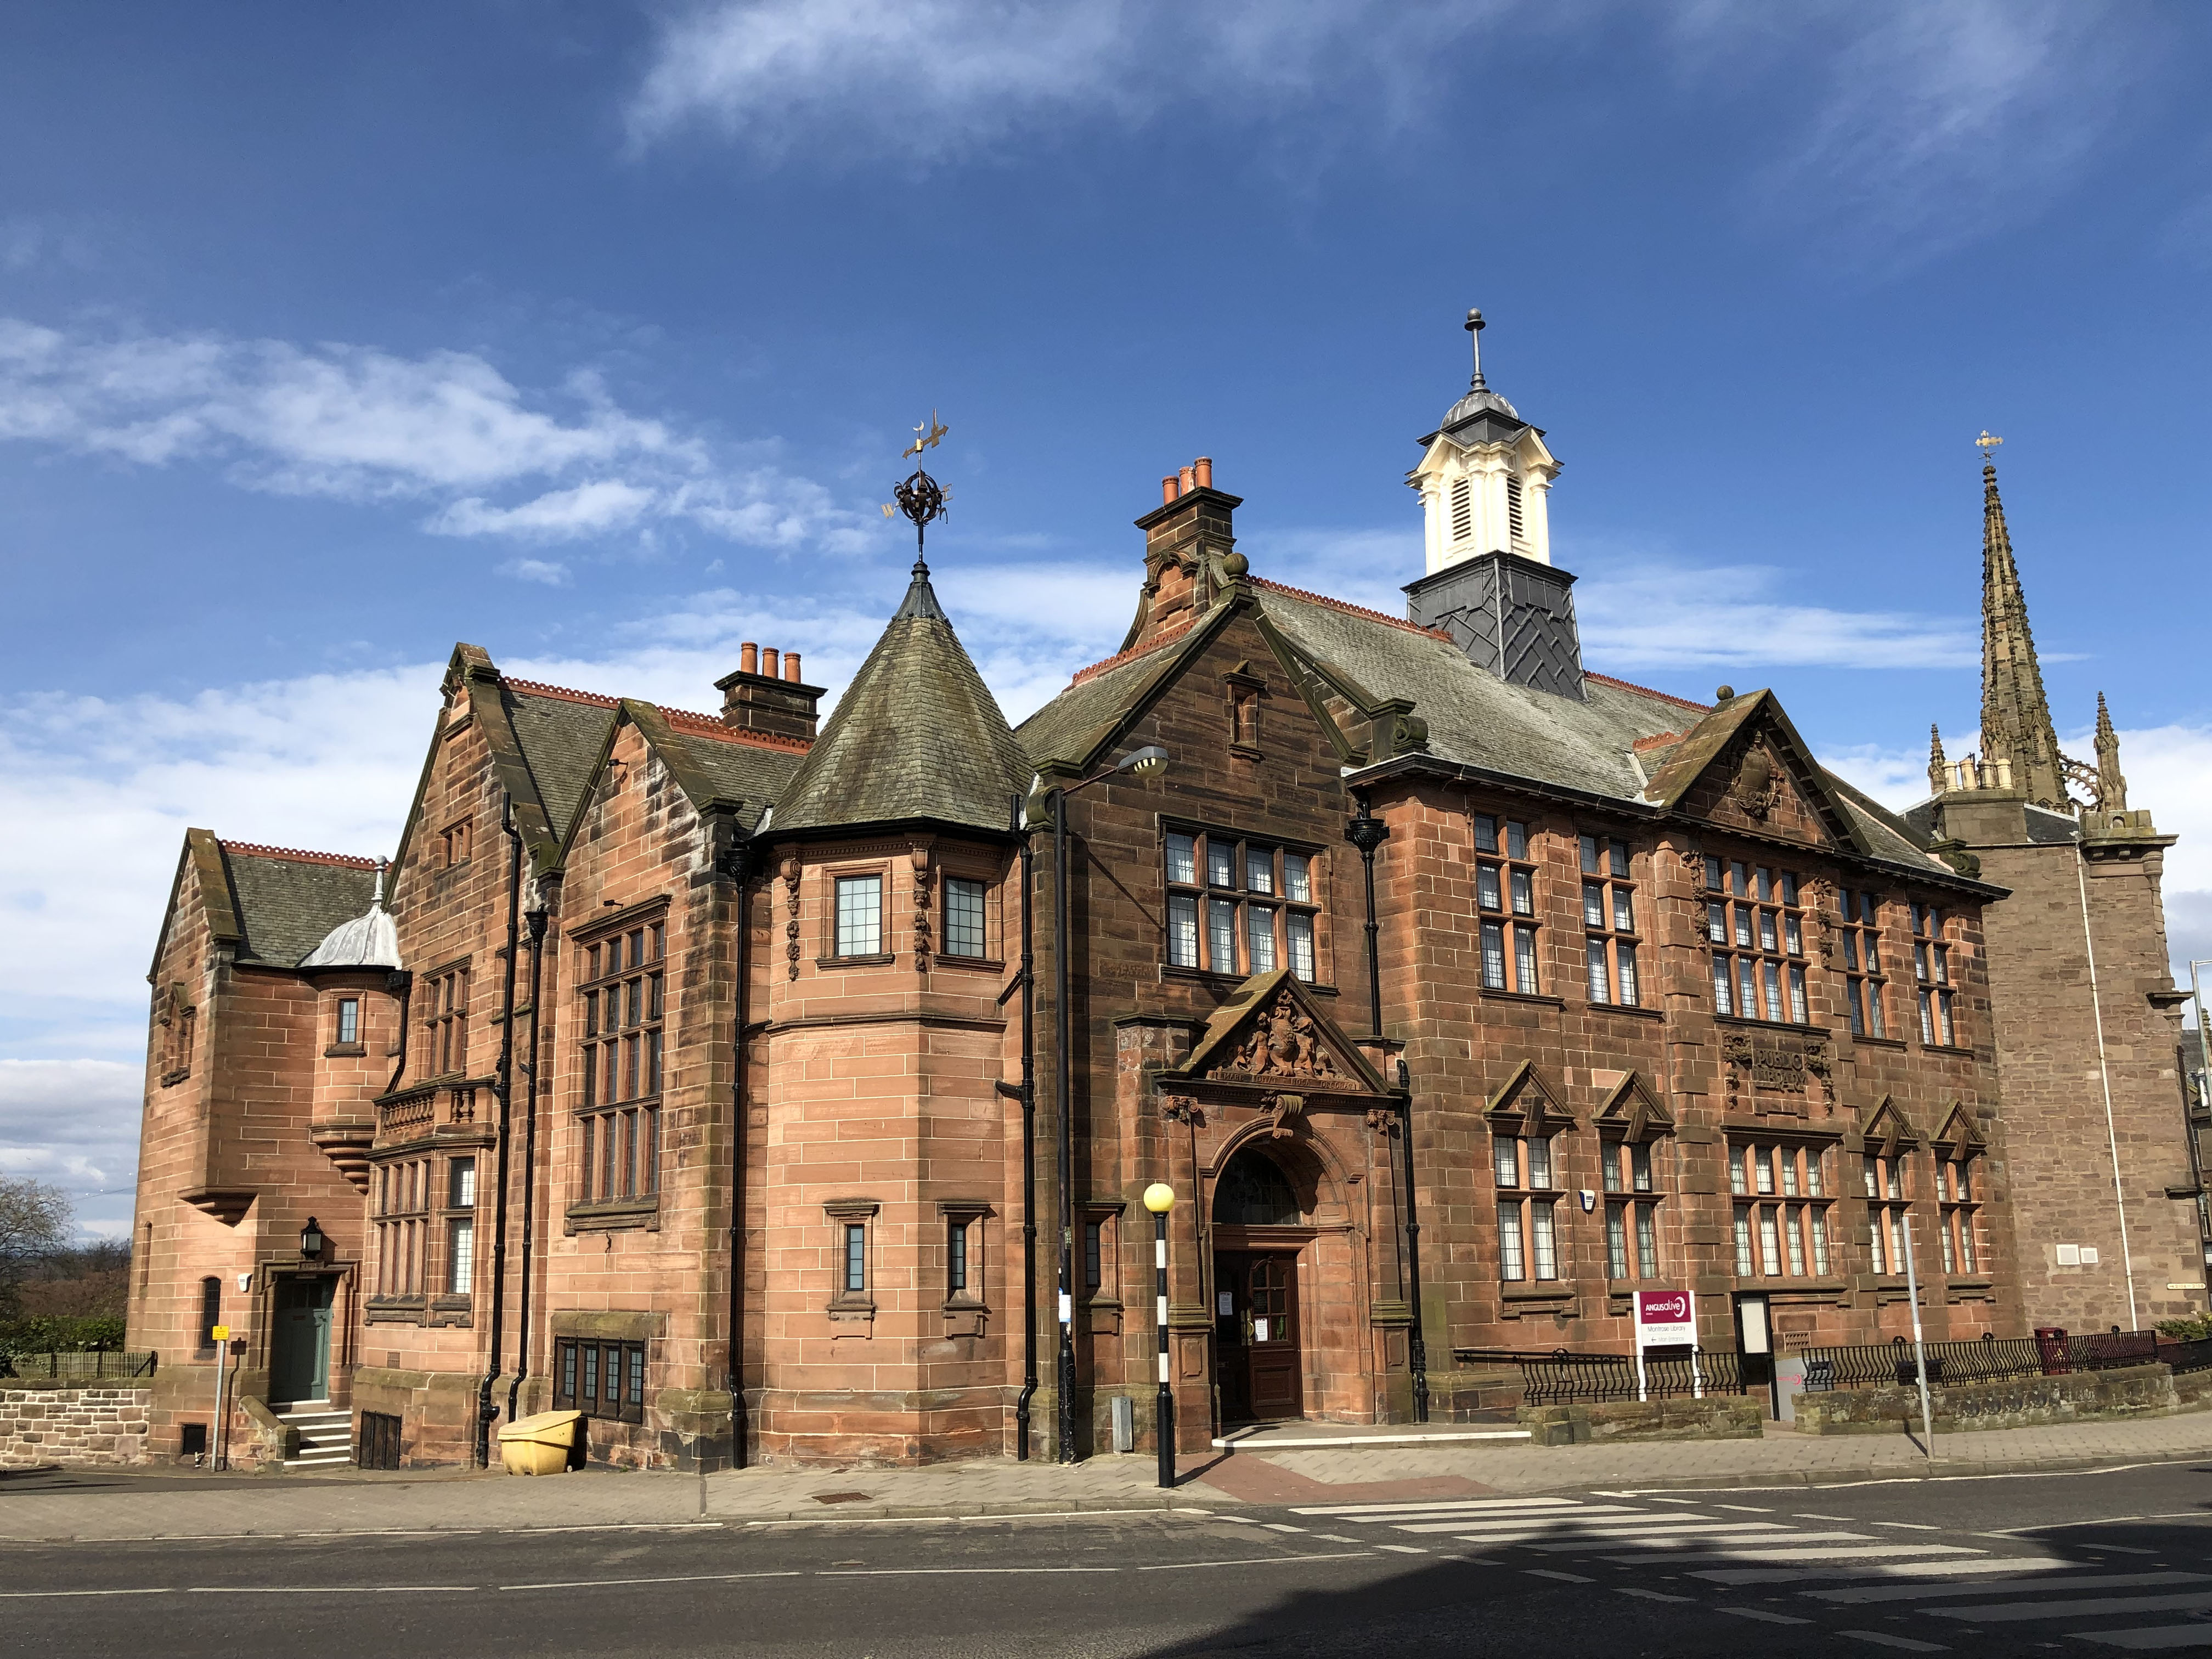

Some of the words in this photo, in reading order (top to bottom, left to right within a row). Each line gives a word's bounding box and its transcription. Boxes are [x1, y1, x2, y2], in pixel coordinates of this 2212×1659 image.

[1755, 1049, 1803, 1071] PUBLIC
[1753, 1070, 1809, 1093] LIBRARY
[1645, 1299, 1680, 1311] ANGUSalive
